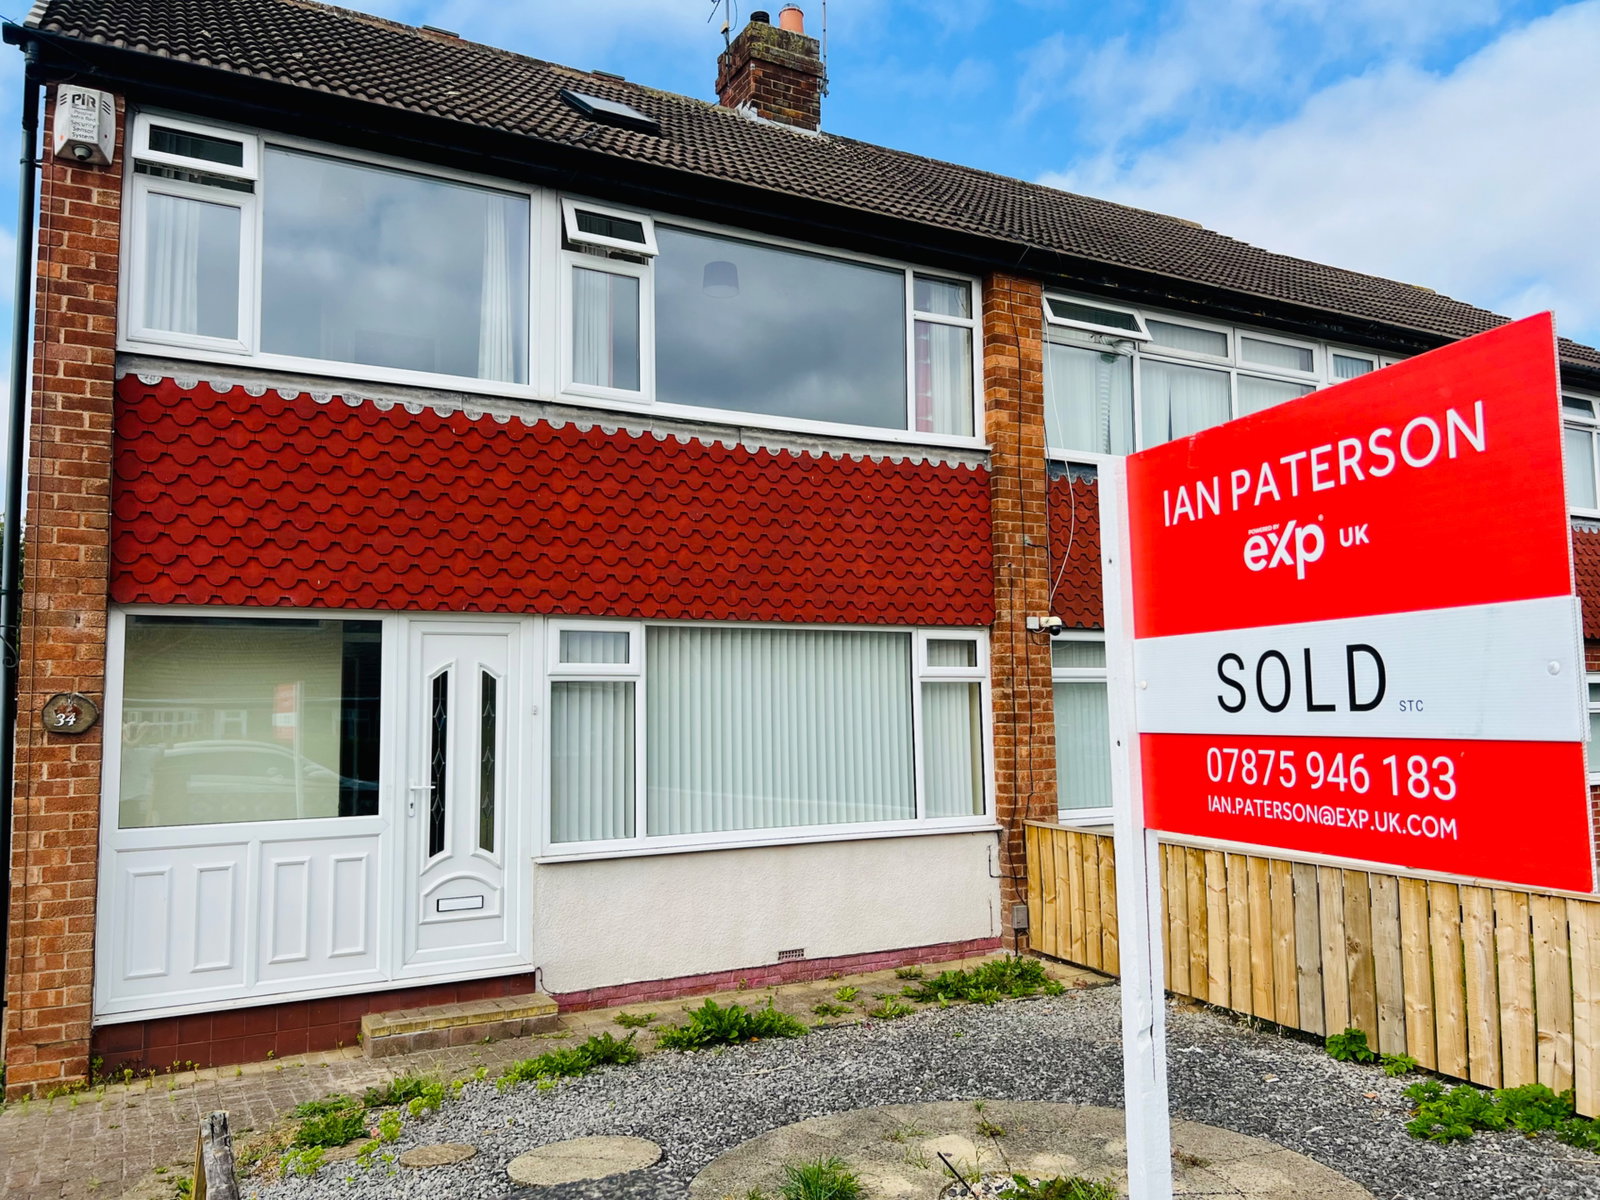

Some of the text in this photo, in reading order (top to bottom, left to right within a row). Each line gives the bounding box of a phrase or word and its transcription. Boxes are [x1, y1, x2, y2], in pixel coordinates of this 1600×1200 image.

[71, 120, 95, 128] Security
[72, 132, 94, 140] System
[1163, 400, 1486, 527] IAN PATERSON
[1248, 525, 1272, 535] POWERED
[1339, 524, 1370, 547] UK
[1217, 643, 1424, 713] SOLD STC
[54, 713, 76, 727] 34
[1206, 747, 1457, 801] 07875 946 183
[1207, 794, 1458, 840] IAN.PATERSON@EXP.UK.COM
